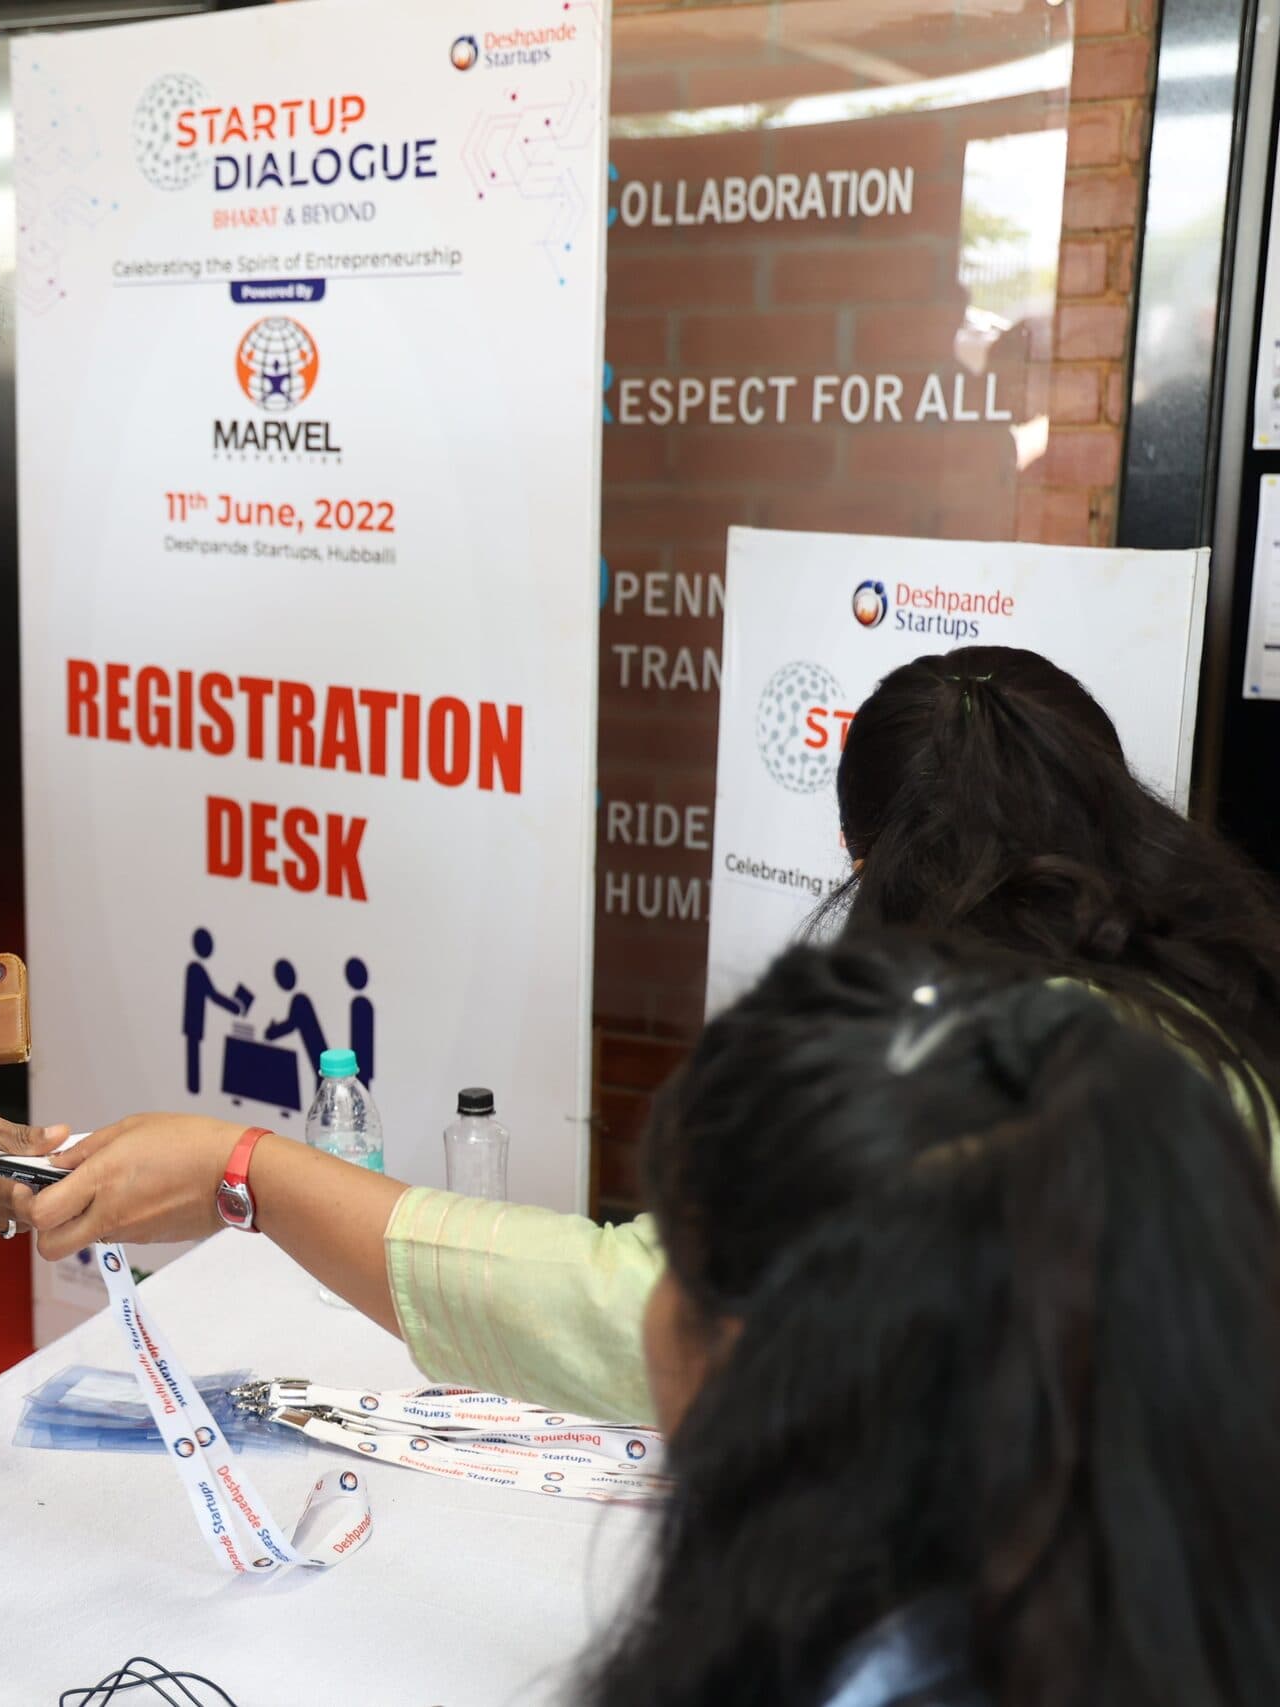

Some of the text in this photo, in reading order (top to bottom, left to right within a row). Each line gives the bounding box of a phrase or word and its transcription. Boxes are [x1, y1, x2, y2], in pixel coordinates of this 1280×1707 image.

[483, 22, 576, 51] Deshpande
[484, 48, 551, 69] Startups
[176, 94, 366, 149] STARTUP
[214, 139, 438, 191] DIALOGUE
[212, 201, 377, 230] BHARAT & BEYOND
[112, 246, 463, 279] Celebrating the Spirit of Entrepreneurship
[811, 374, 902, 422] FOR
[914, 373, 1013, 422] ALL
[213, 420, 342, 453] MARVEL
[165, 491, 396, 534] 11th June, 2022
[164, 535, 397, 565] Deshpande Startups, Hubballi
[599, 553, 726, 619] PENN
[895, 583, 1015, 616] Deshpande
[895, 609, 980, 640] Startups
[66, 659, 523, 796] REGISTRATION
[597, 789, 710, 850] RIDE
[206, 794, 370, 903] DESK
[604, 870, 712, 922] HUM
[724, 853, 823, 897] Celebrating
[533, 1432, 601, 1447] Deshpande
[541, 1453, 593, 1464] Startups
[216, 1465, 262, 1529] Deshpande
[467, 1472, 517, 1486] Startups
[198, 1481, 226, 1535] Startups
